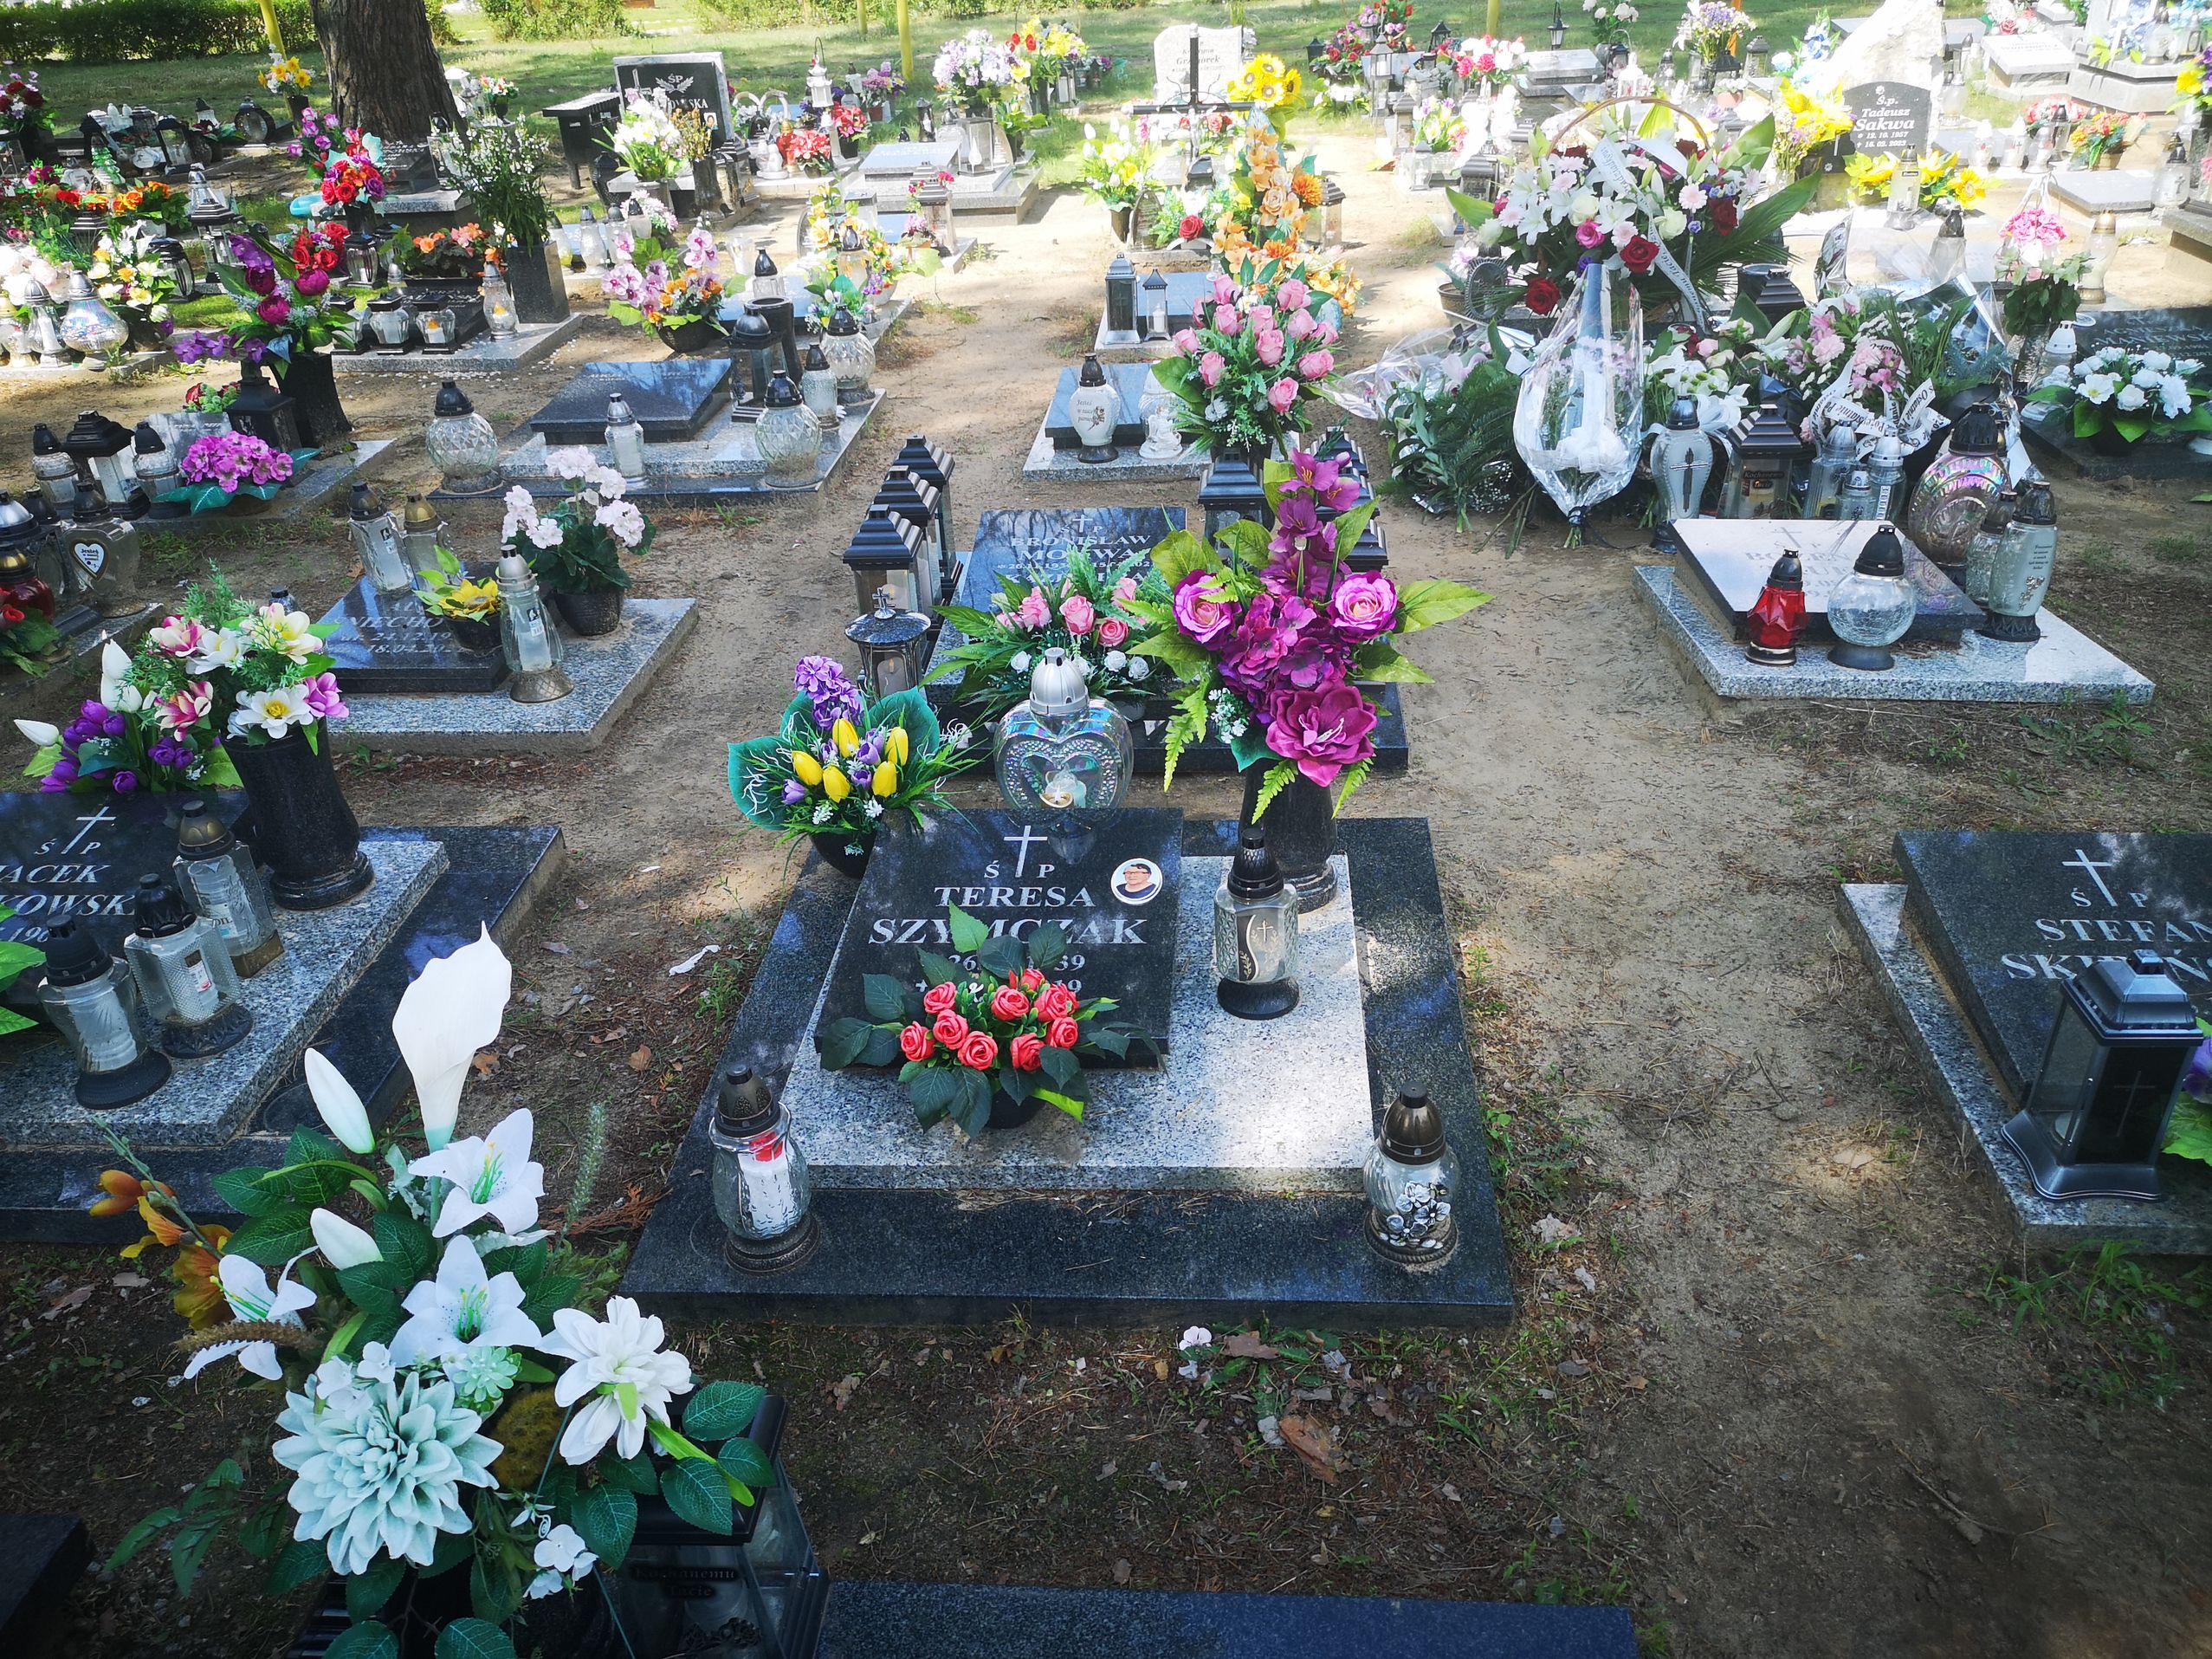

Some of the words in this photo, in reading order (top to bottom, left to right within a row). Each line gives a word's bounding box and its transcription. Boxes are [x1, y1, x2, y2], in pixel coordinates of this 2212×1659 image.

[1861, 107, 1911, 118] Tadeusz
[1853, 118, 1915, 131] Sakwa
[1835, 405, 1865, 424] statnie
[35, 838, 57, 855] Ś
[80, 841, 101, 855] P
[984, 859, 999, 878] Ś
[1038, 864, 1055, 878] P
[0, 894, 136, 917] KOWSK
[935, 886, 1096, 907] TERESA
[2071, 887, 2092, 908] Ś
[2129, 892, 2149, 908] P
